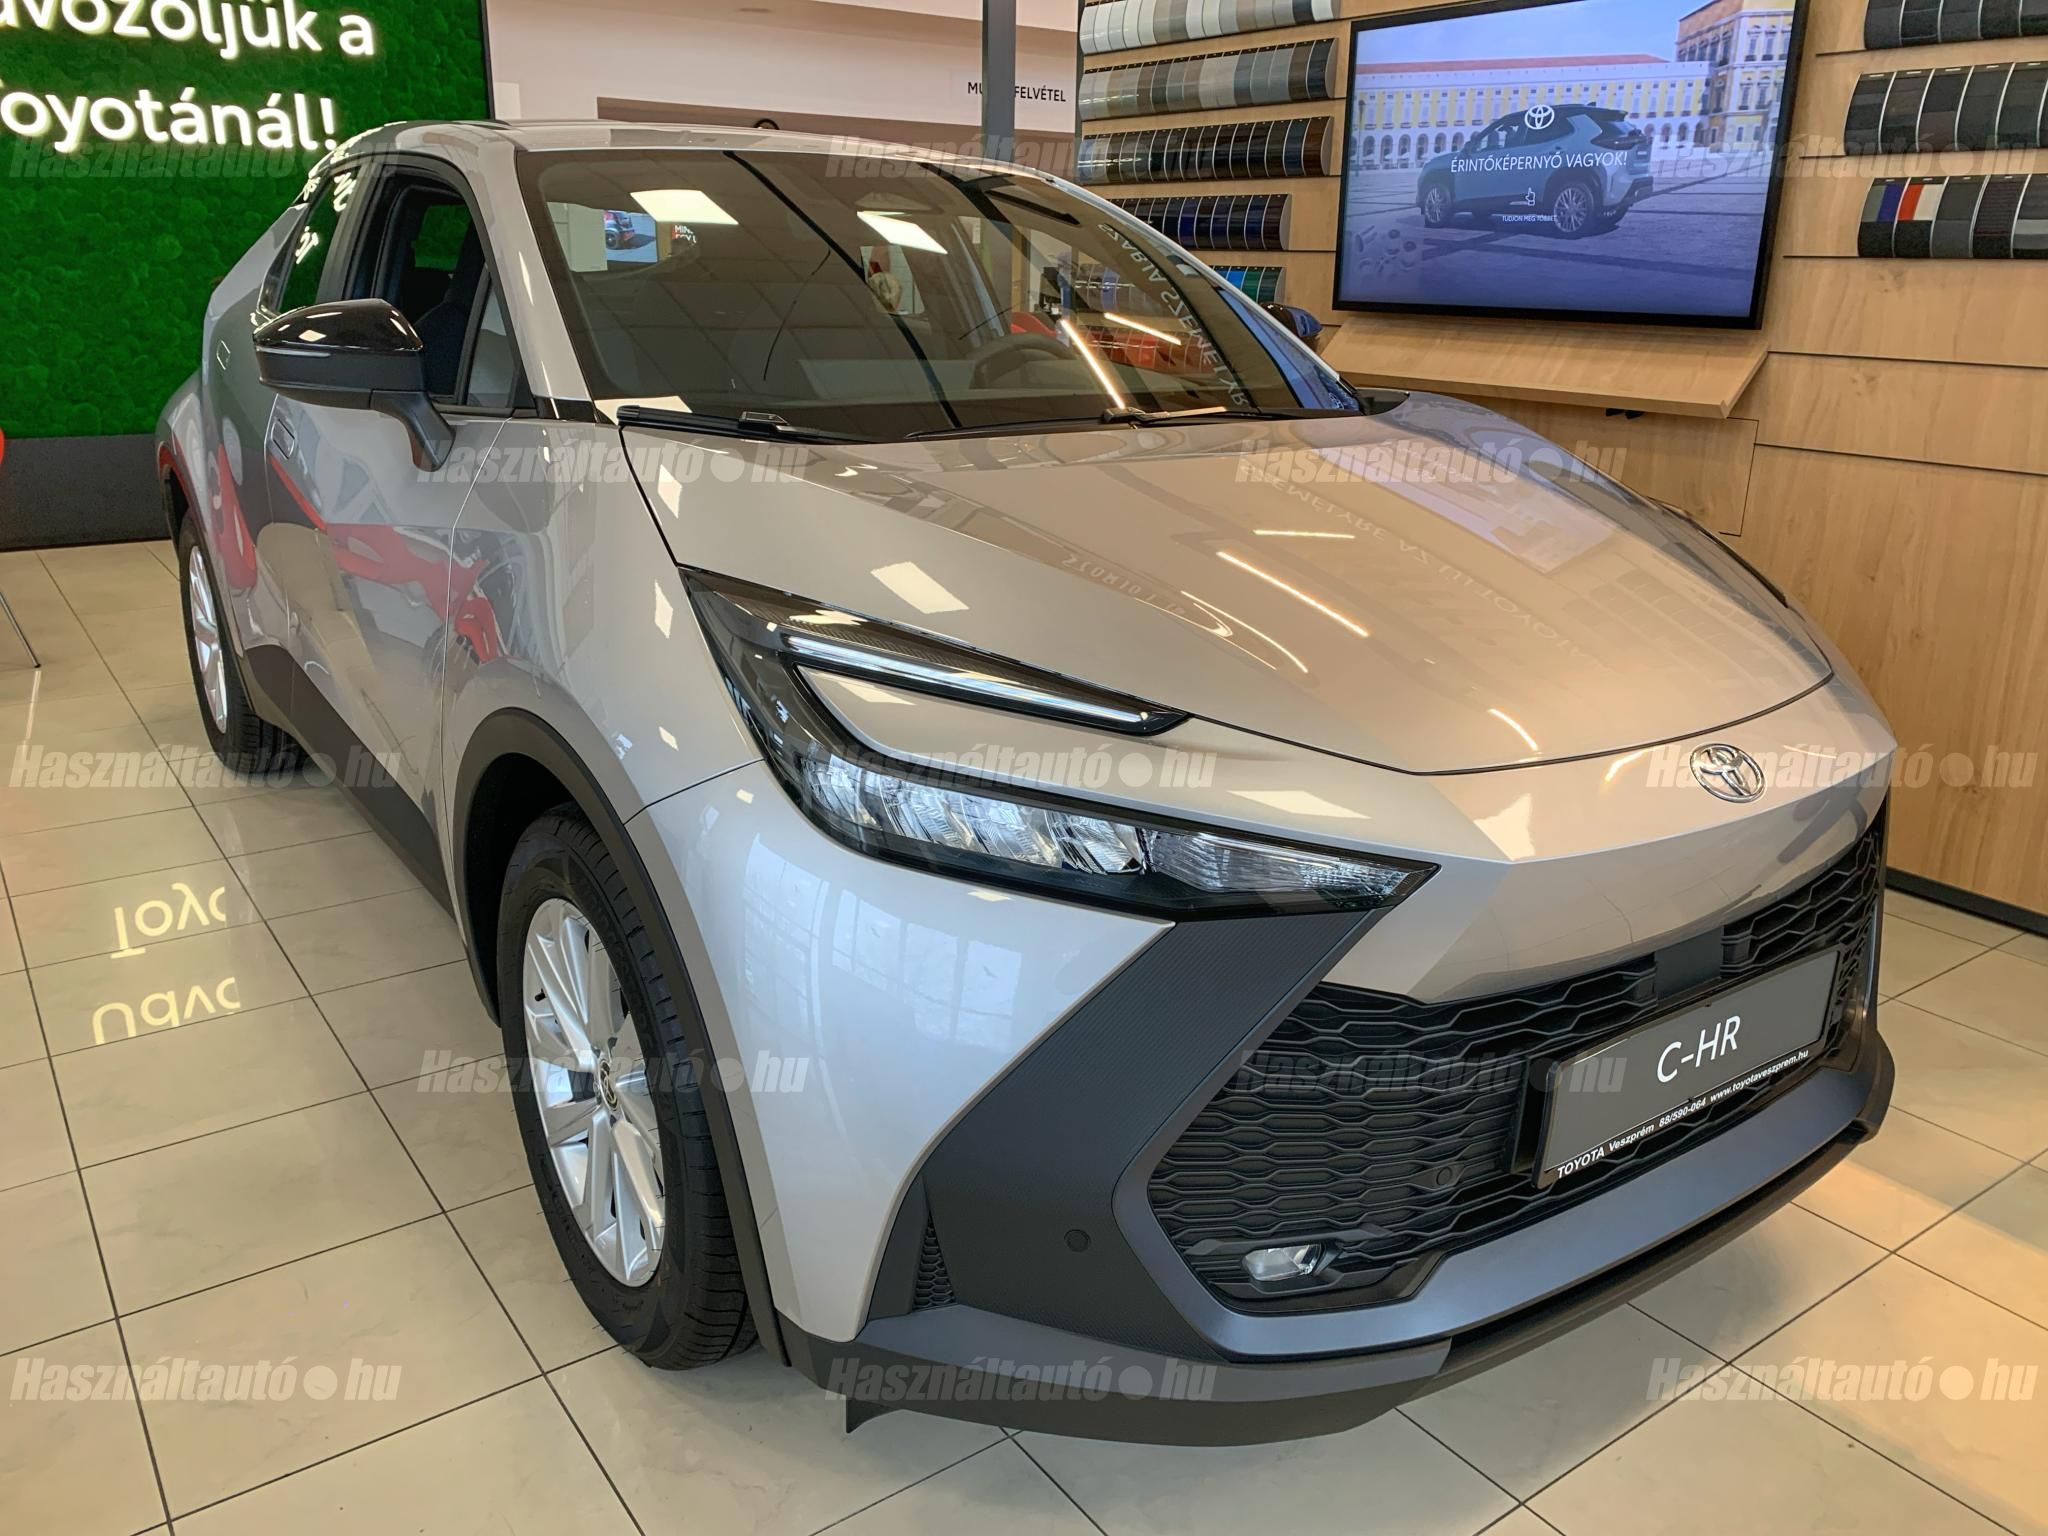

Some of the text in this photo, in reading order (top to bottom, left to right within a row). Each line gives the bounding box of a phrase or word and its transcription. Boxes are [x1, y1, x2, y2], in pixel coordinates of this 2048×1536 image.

[339, 12, 375, 57] a
[0, 79, 340, 153] oyotánál!
[1450, 151, 1628, 173] ÉRINTŐKÉPERNYŐ VAGYOK!
[1657, 1015, 1741, 1083] C-HR
[1557, 1049, 1810, 1180] TOYOTA Veszprém 88/590-064 www.toyotaveszprem.hu
